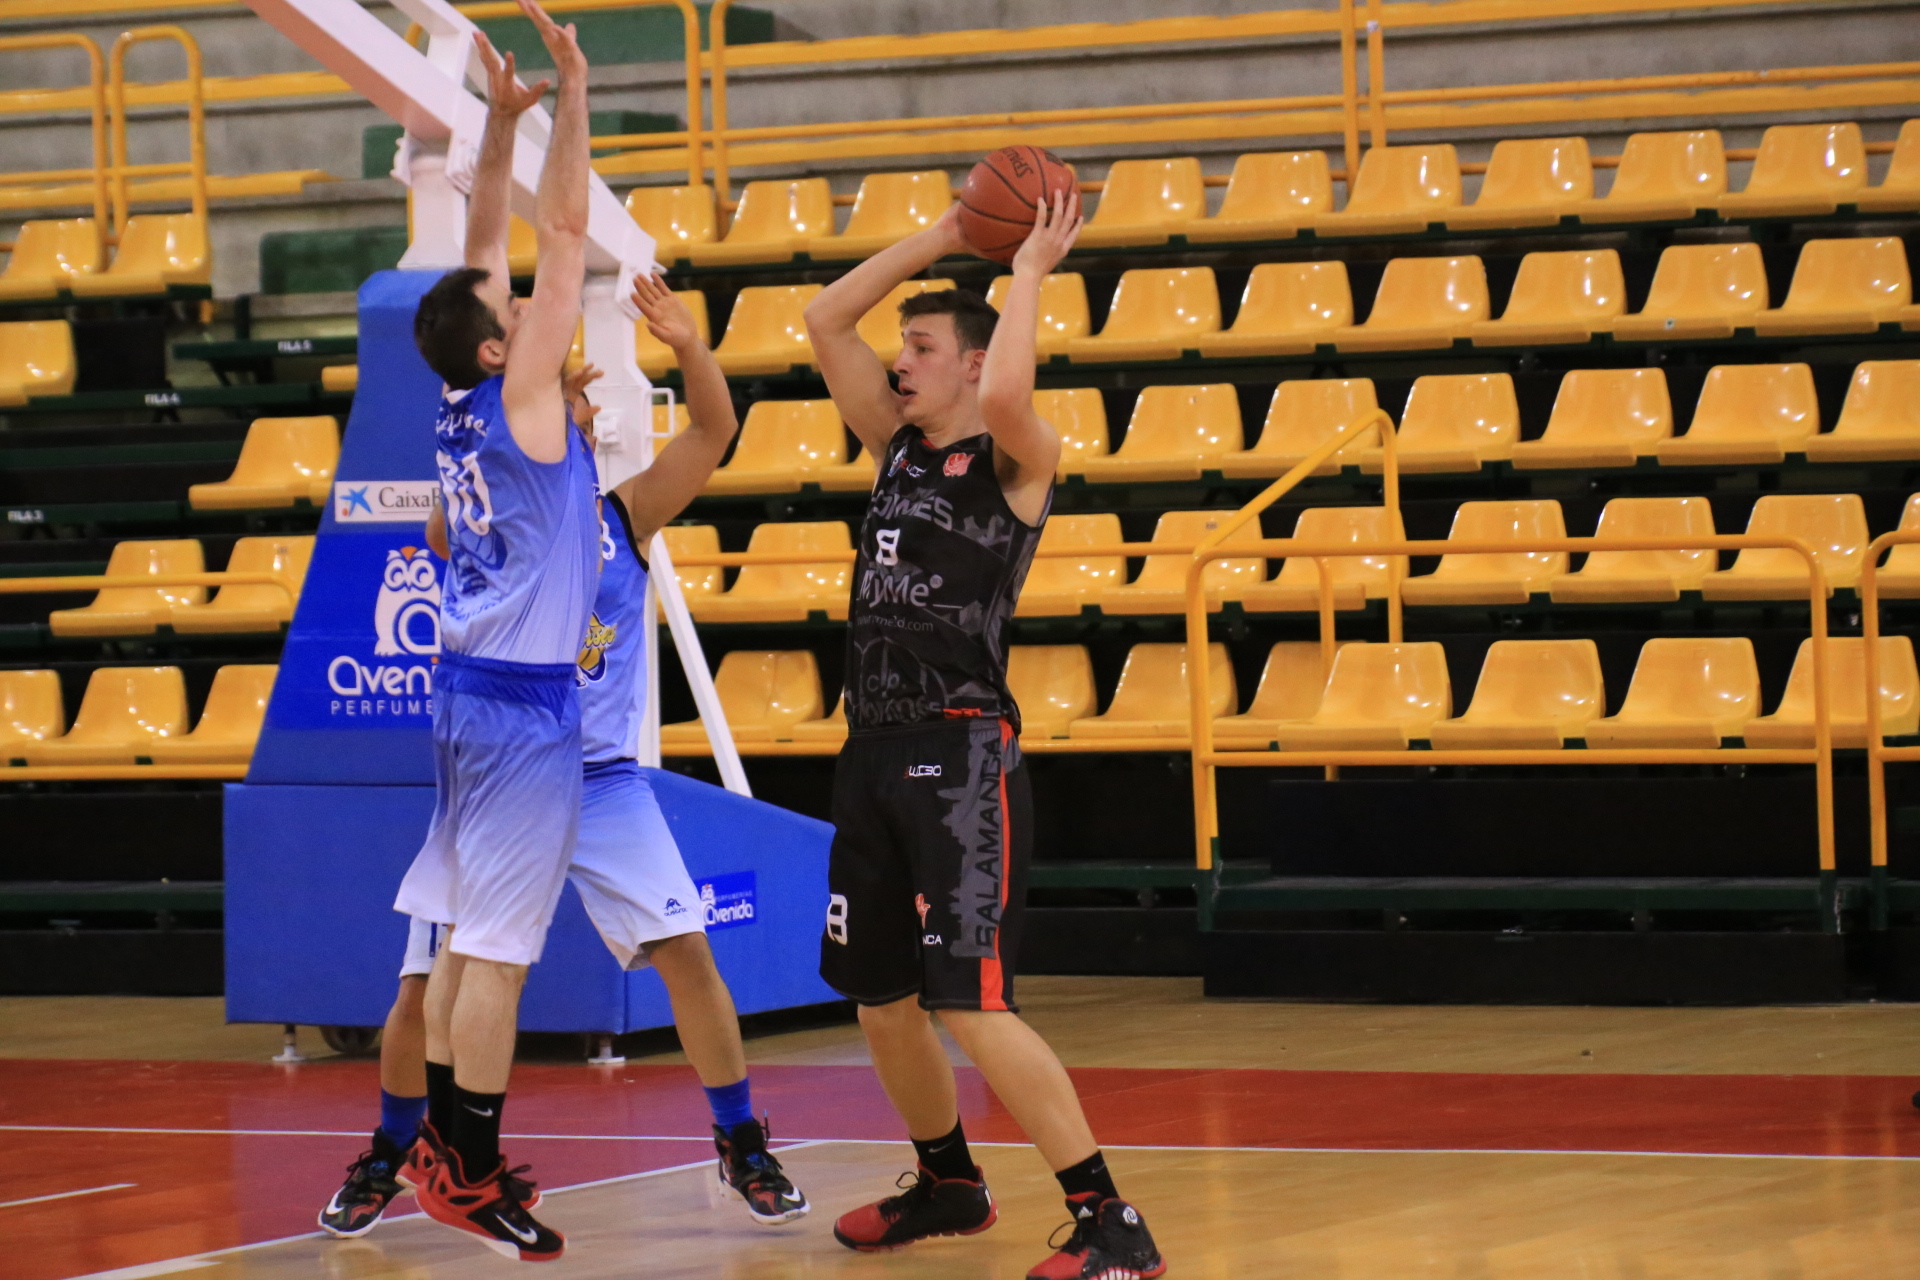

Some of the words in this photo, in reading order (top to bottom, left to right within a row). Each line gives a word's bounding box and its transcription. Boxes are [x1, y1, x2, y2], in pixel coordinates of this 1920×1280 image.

[145, 394, 168, 405] FILA
[8, 510, 31, 522] FILA
[876, 528, 900, 566] 8
[975, 736, 1001, 947] SALAMANCA
[826, 893, 848, 946] 8
